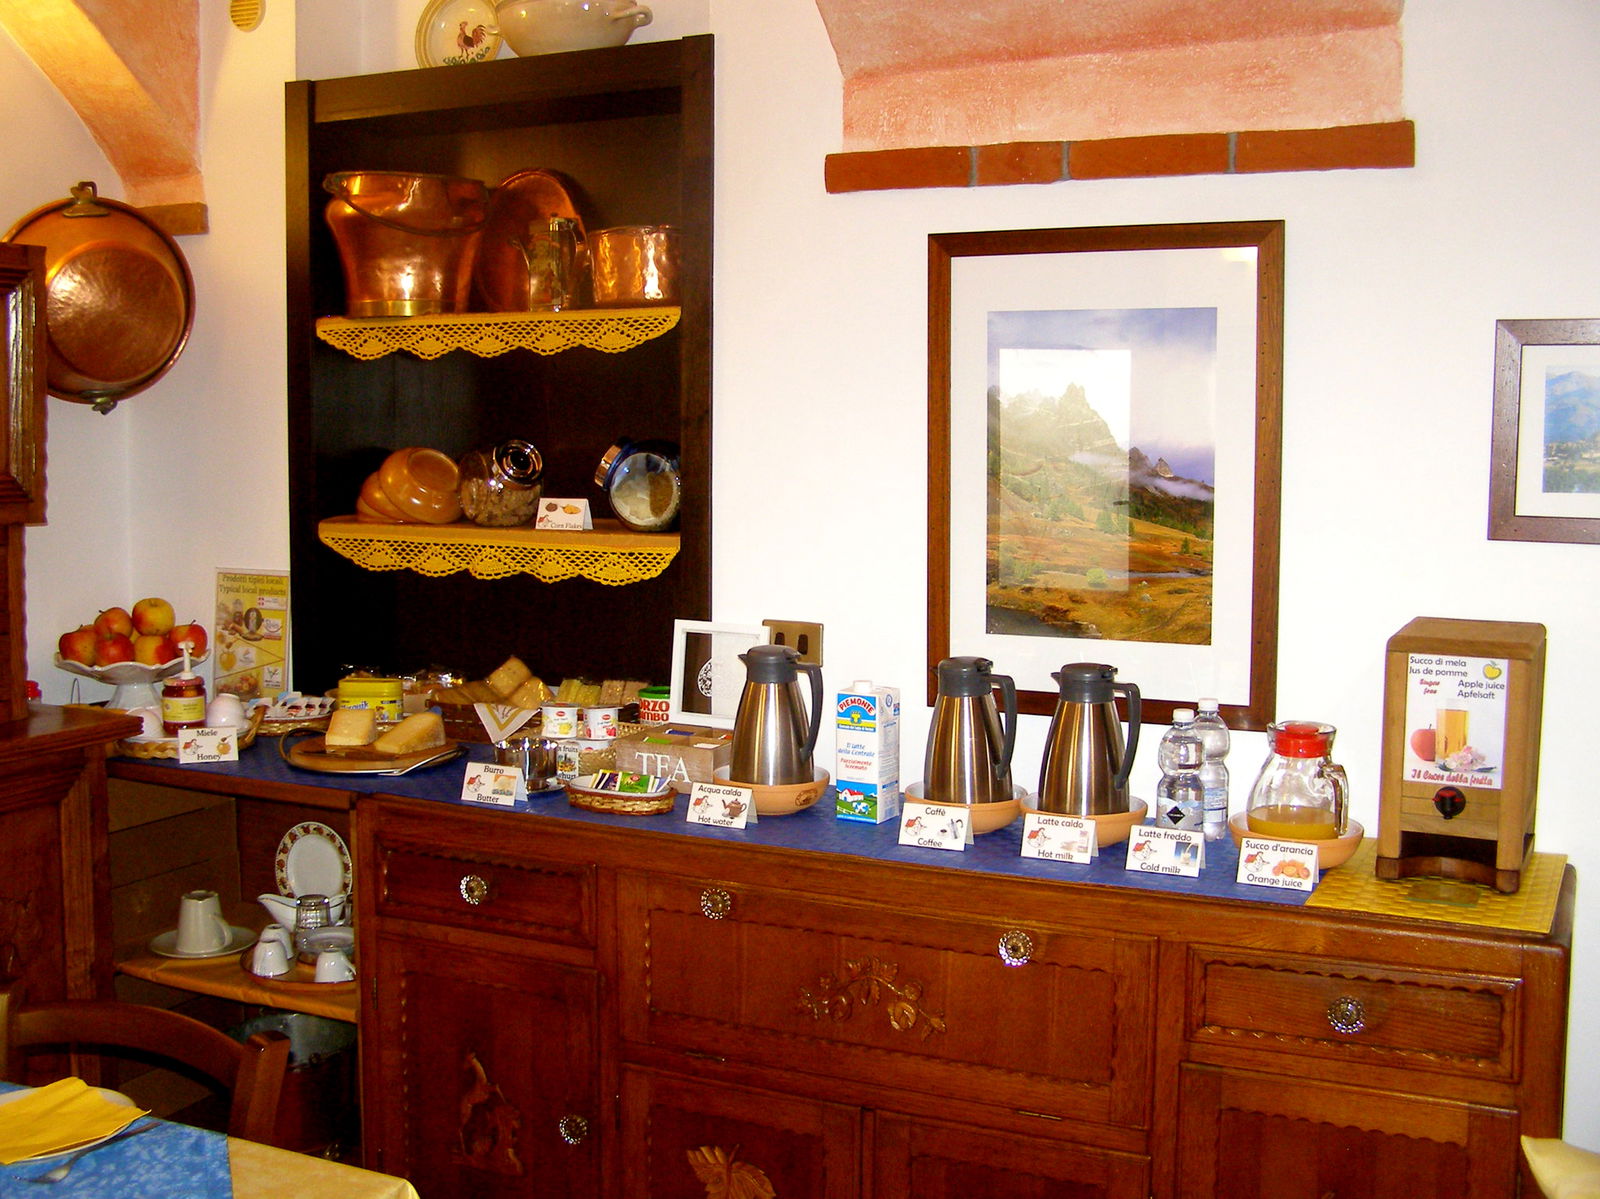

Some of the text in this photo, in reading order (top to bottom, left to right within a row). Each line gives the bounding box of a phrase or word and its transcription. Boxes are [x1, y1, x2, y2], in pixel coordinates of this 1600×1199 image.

[1410, 656, 1467, 667] Succo di mela
[1423, 667, 1433, 675] de
[1435, 669, 1468, 678] pomme
[1458, 680, 1505, 690] Apple juice
[1457, 689, 1495, 699] Apfelsaft
[839, 698, 875, 713] PIEMONTE
[640, 711, 669, 721] IMBO
[197, 753, 221, 761] Honey
[484, 765, 504, 774] Burro
[635, 752, 692, 783] TEA
[698, 785, 742, 797] Acqua calda
[477, 793, 499, 803] Butter
[925, 807, 946, 816] Caffè
[698, 815, 733, 826] Hot water
[1038, 817, 1084, 829] Latte caldo
[1139, 829, 1192, 841] Latte freddo
[917, 838, 942, 847] Coffee
[1245, 840, 1314, 856] Succo d'arancia
[1038, 849, 1074, 860] Hot milk
[1140, 862, 1181, 874] Cold milk
[1247, 873, 1303, 888] Orange juice
